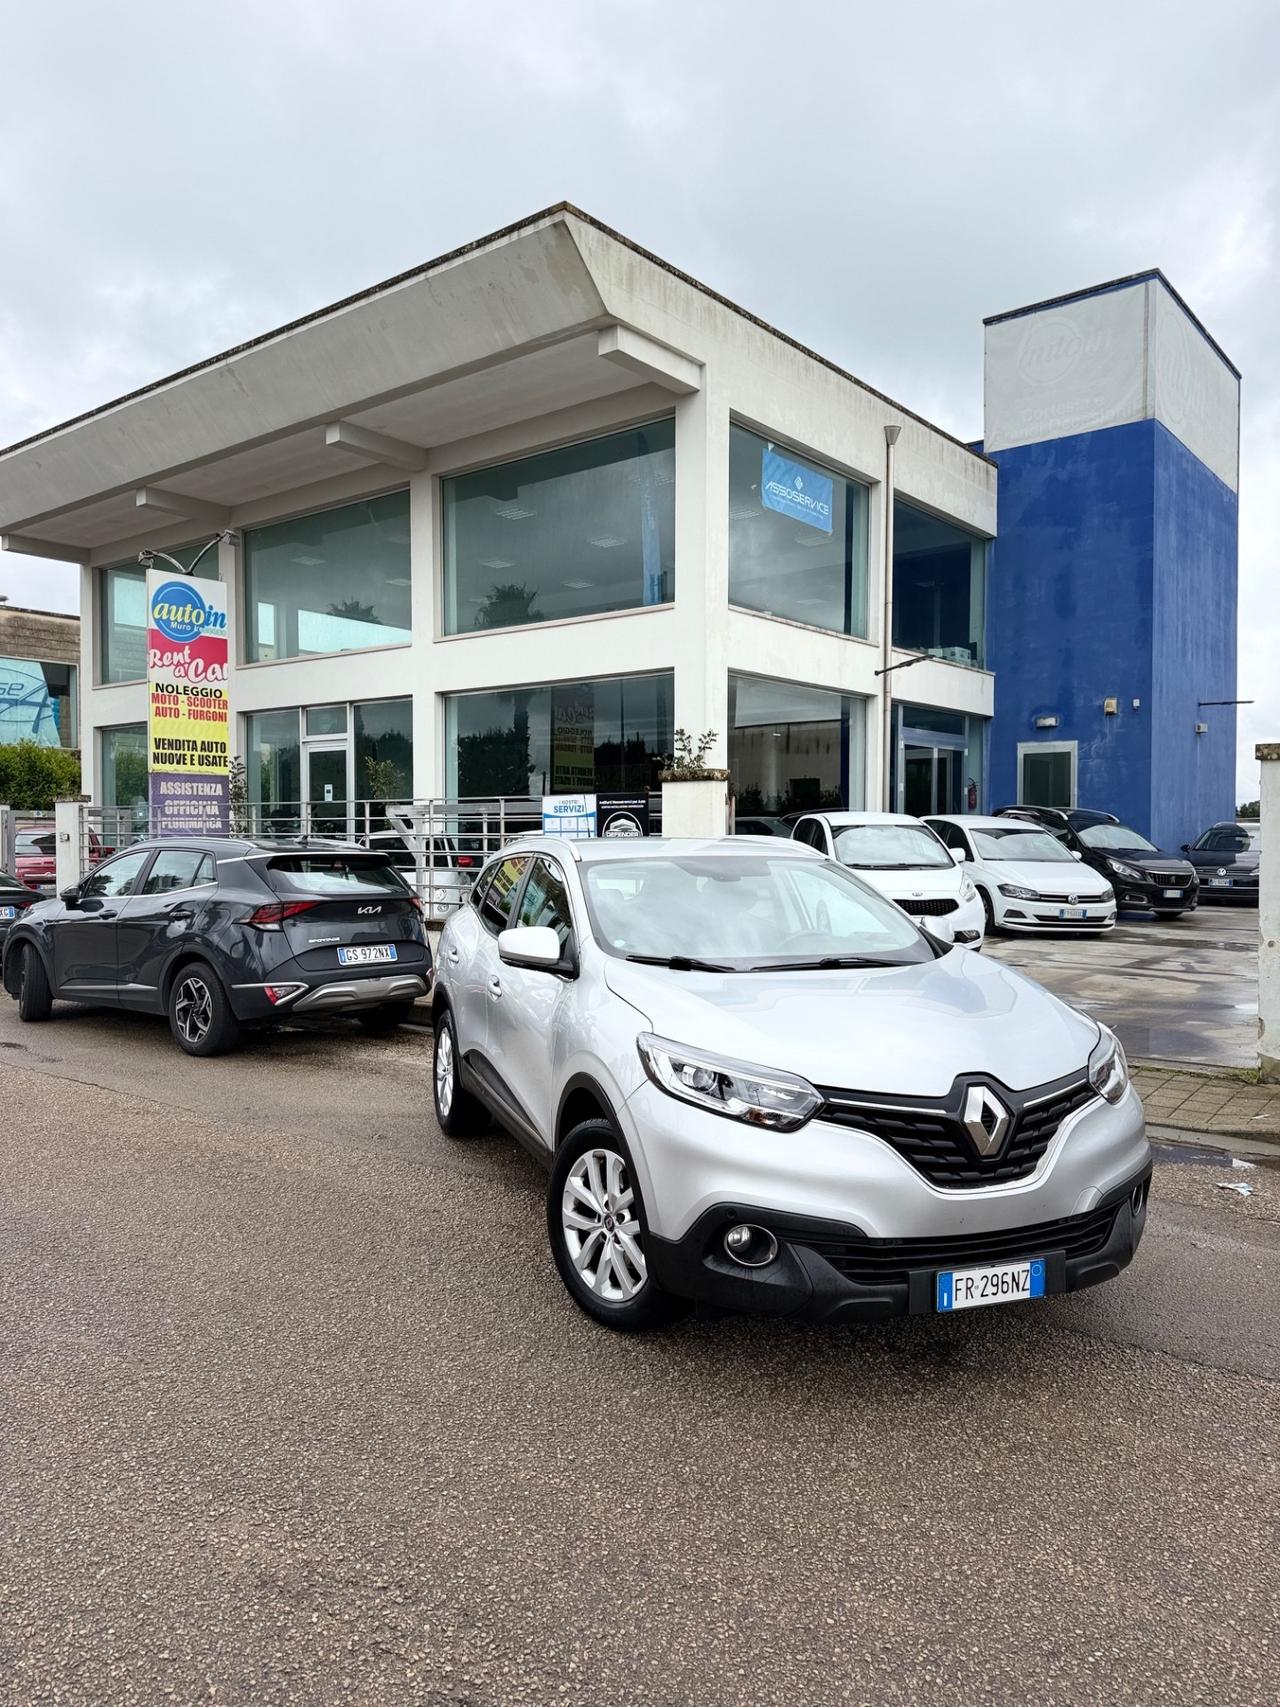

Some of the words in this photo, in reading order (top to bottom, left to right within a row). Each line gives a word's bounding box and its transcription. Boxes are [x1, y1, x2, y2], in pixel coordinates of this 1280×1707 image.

[765, 481, 829, 515] ASSOSERVICE
[170, 621, 192, 631] Muro
[149, 645, 192, 668] Rent
[155, 683, 223, 699] NOLEGGIO
[151, 693, 179, 706] MOTO
[186, 696, 228, 710] SCOOTER
[154, 706, 180, 719] AUTO
[188, 709, 228, 722] FURGONI
[154, 737, 198, 752] VENDITA
[200, 740, 227, 754] AUTO
[152, 752, 188, 766] NUOVE
[190, 754, 195, 766] E
[198, 754, 228, 767] USATE
[160, 782, 223, 796] ASSISTENZA
[164, 800, 219, 815] OFFICINA
[553, 805, 584, 813] SERVIZI
[346, 949, 359, 961] GS
